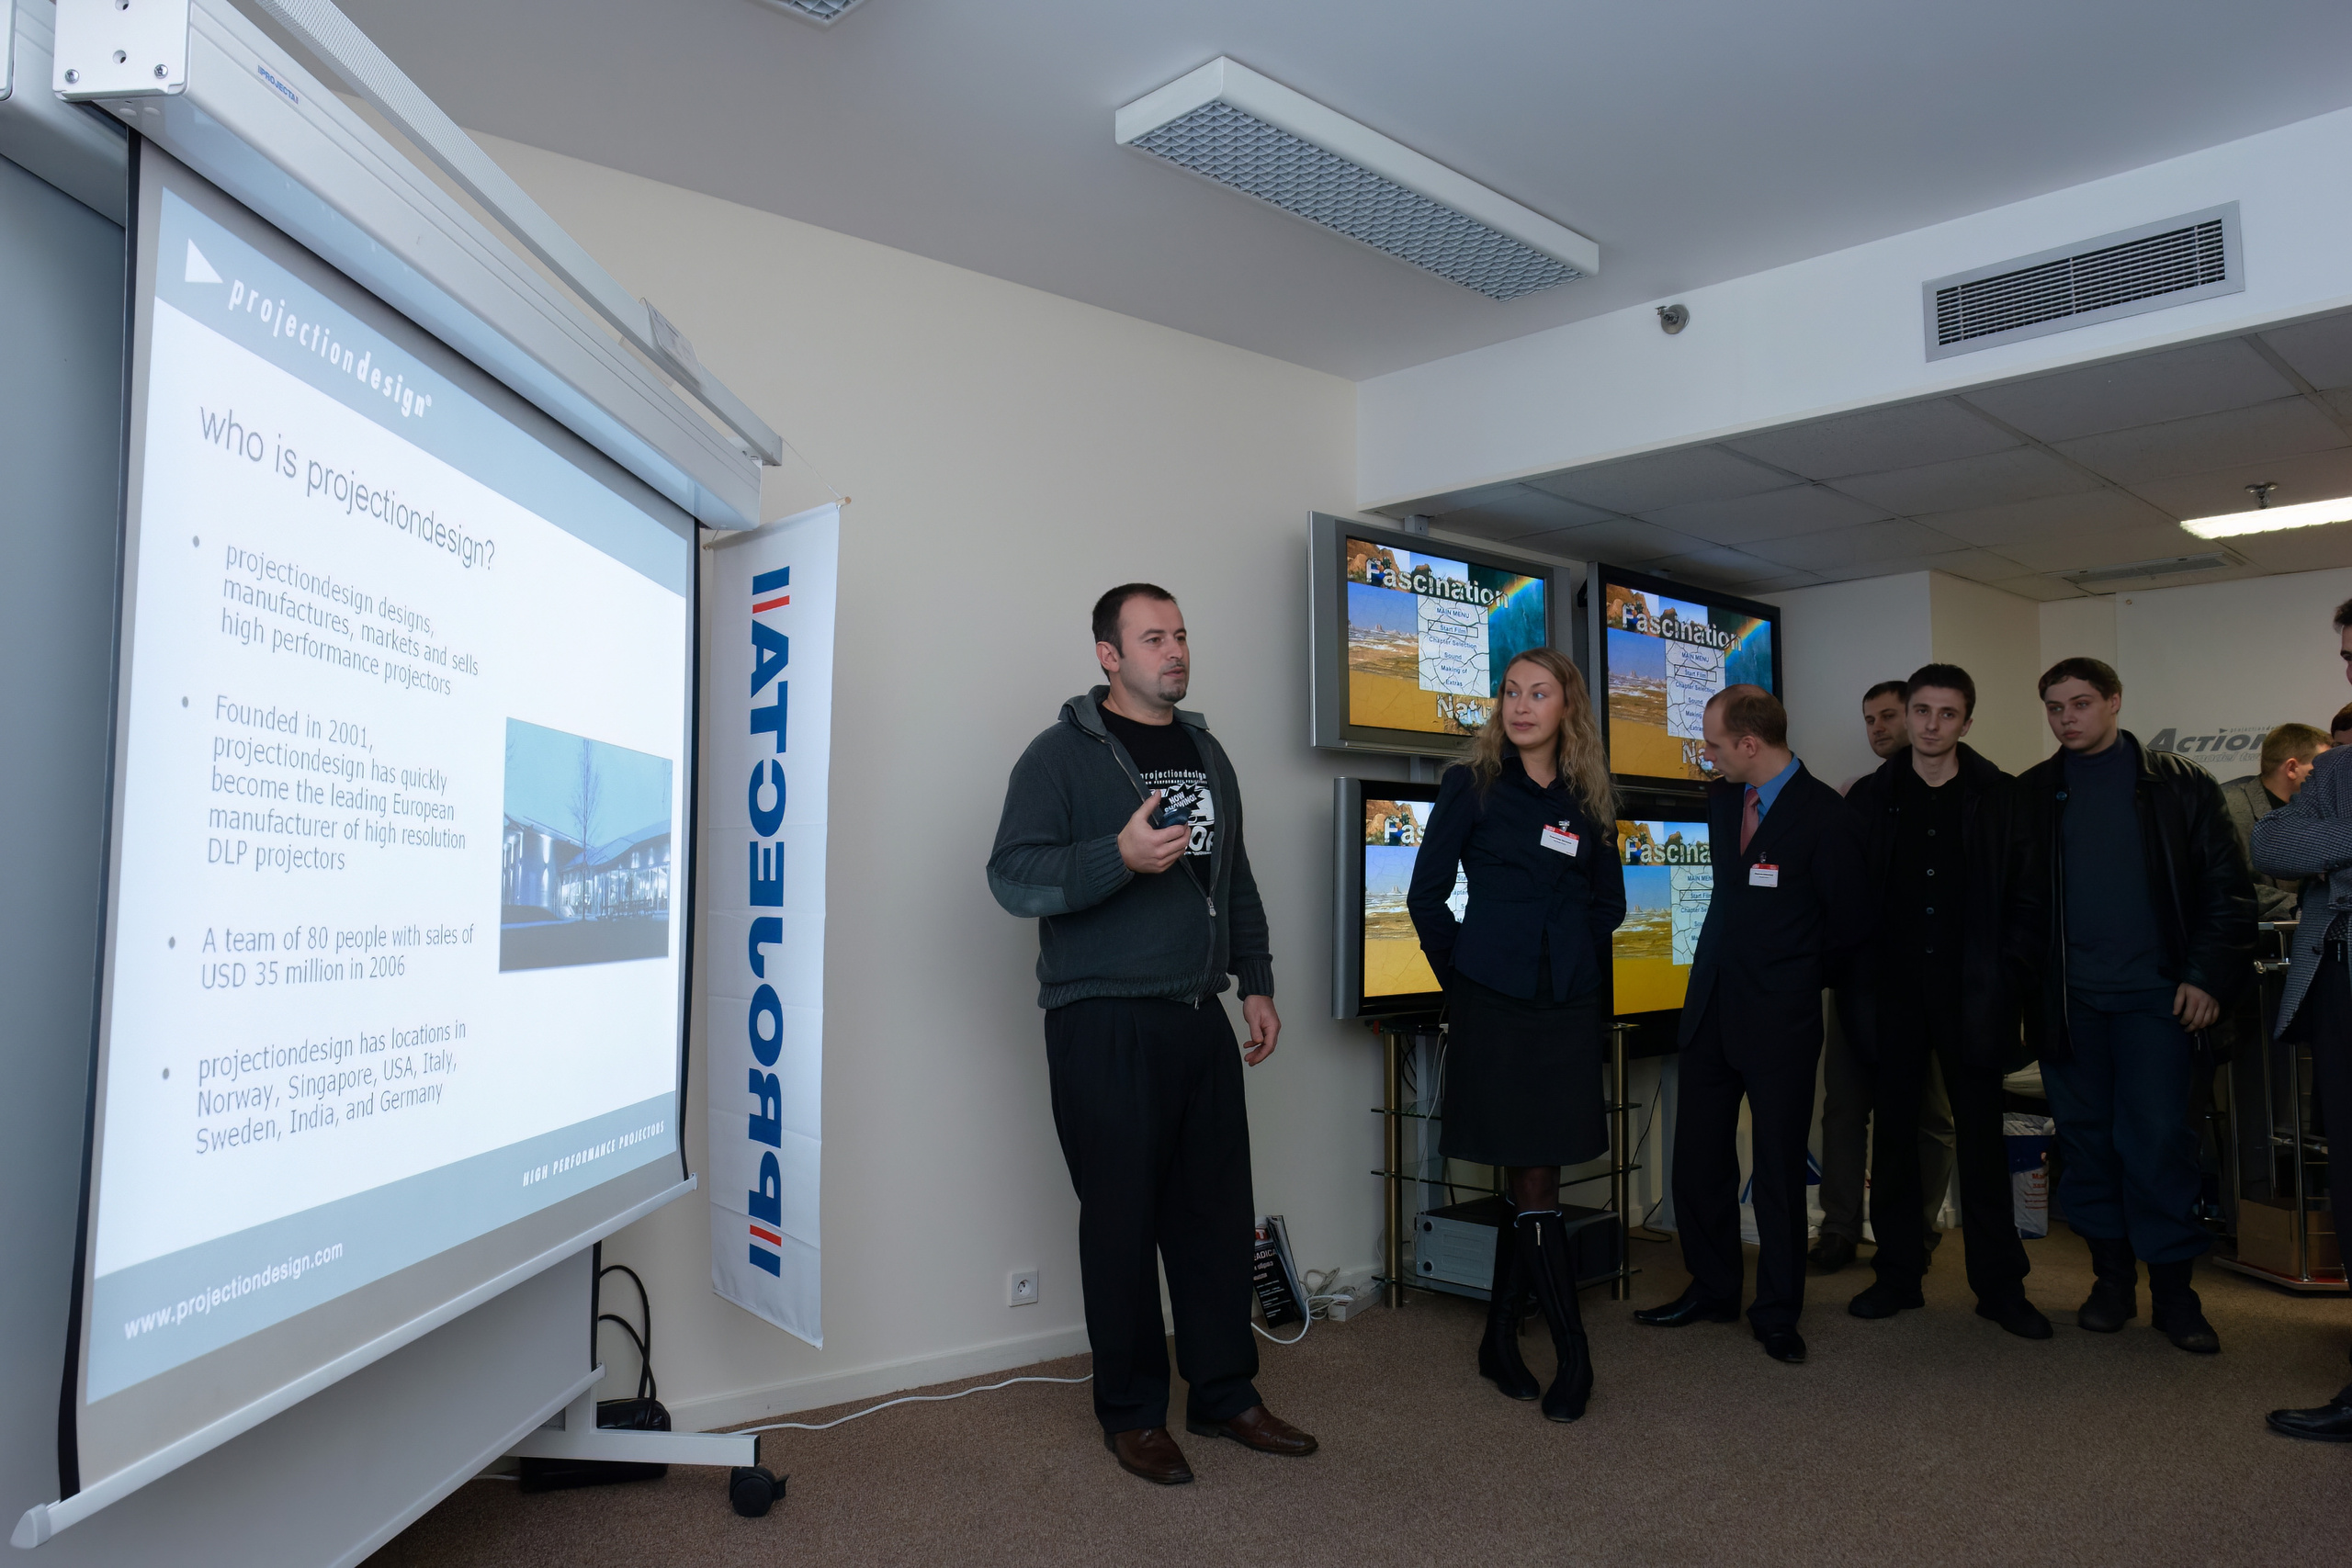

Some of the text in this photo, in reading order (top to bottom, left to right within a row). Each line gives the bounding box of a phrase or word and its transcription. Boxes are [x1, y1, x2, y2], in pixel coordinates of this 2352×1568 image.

[199, 406, 495, 570] who is projectiondesign?
[226, 545, 435, 638] projectiondesign designs,
[1365, 557, 1509, 609] Fascination
[223, 578, 479, 676] manufactures, markets and sells
[1436, 607, 1470, 619] MAIN MENU
[1440, 624, 1466, 635] Start Film
[1622, 602, 1742, 651] Fascination
[221, 607, 452, 695] high performance projectors
[1429, 636, 1477, 650] Chapter Selection
[1443, 651, 1463, 660] Sound
[1681, 652, 1709, 663] MAIN MENU
[1441, 665, 1461, 675] Making
[1445, 679, 1464, 687] Extras
[1675, 681, 1716, 694] Chapter Selection
[1684, 669, 1707, 679] Start Film
[1437, 694, 1491, 722] Natu
[1688, 696, 1703, 705] Sound
[216, 694, 374, 753] Founded in 2001,
[213, 735, 447, 796] projectiondesign has quickly
[211, 765, 455, 823] become the leading European
[1168, 791, 1185, 805] NOW
[209, 807, 466, 850] manufacturer of high resolution
[208, 838, 345, 873] DLP projectors
[1625, 837, 1712, 863] Fascina
[1680, 907, 1700, 915] Chapter
[202, 923, 474, 954] A team of 80 people with sales of
[202, 954, 405, 989] USD 35 million in 2006
[198, 1020, 466, 1087] projectiondesign has locations in
[198, 1049, 458, 1118] Norway, Singapore, USA, Italy,
[197, 1082, 444, 1155] Sweden, India, and Germany
[523, 1120, 664, 1187] HIGH PERFORMANCE PROJECTORS
[124, 1242, 344, 1340] www.projectiondesign.com
